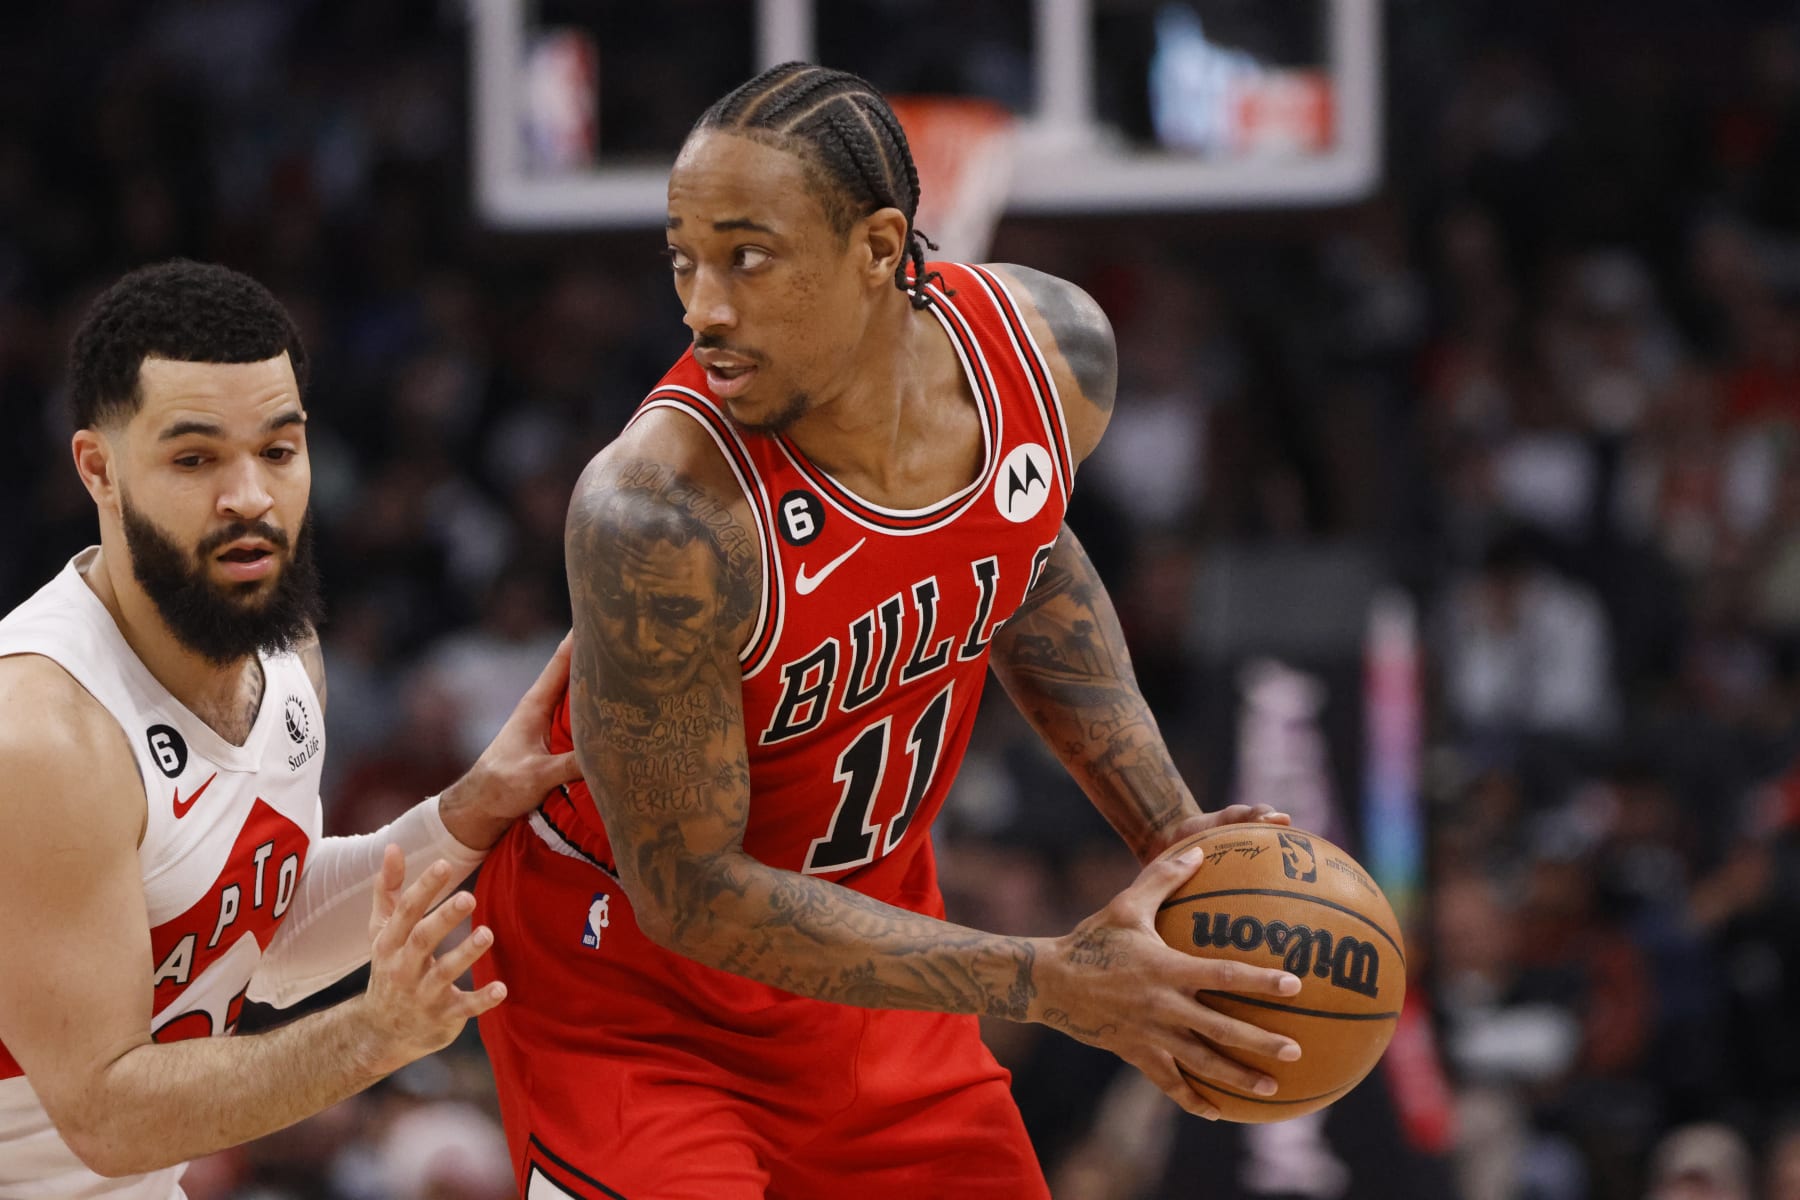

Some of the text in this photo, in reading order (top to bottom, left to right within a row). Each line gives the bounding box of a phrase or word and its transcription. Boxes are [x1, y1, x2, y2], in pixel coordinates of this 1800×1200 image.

[783, 497, 815, 540] 6
[651, 715, 706, 747] SURE
[152, 733, 180, 774] 6
[288, 736, 319, 772] Sun Life
[624, 781, 709, 815] PERFECT
[802, 679, 956, 875] 11
[154, 840, 299, 986] APTO
[1192, 911, 1380, 999] Wilson
